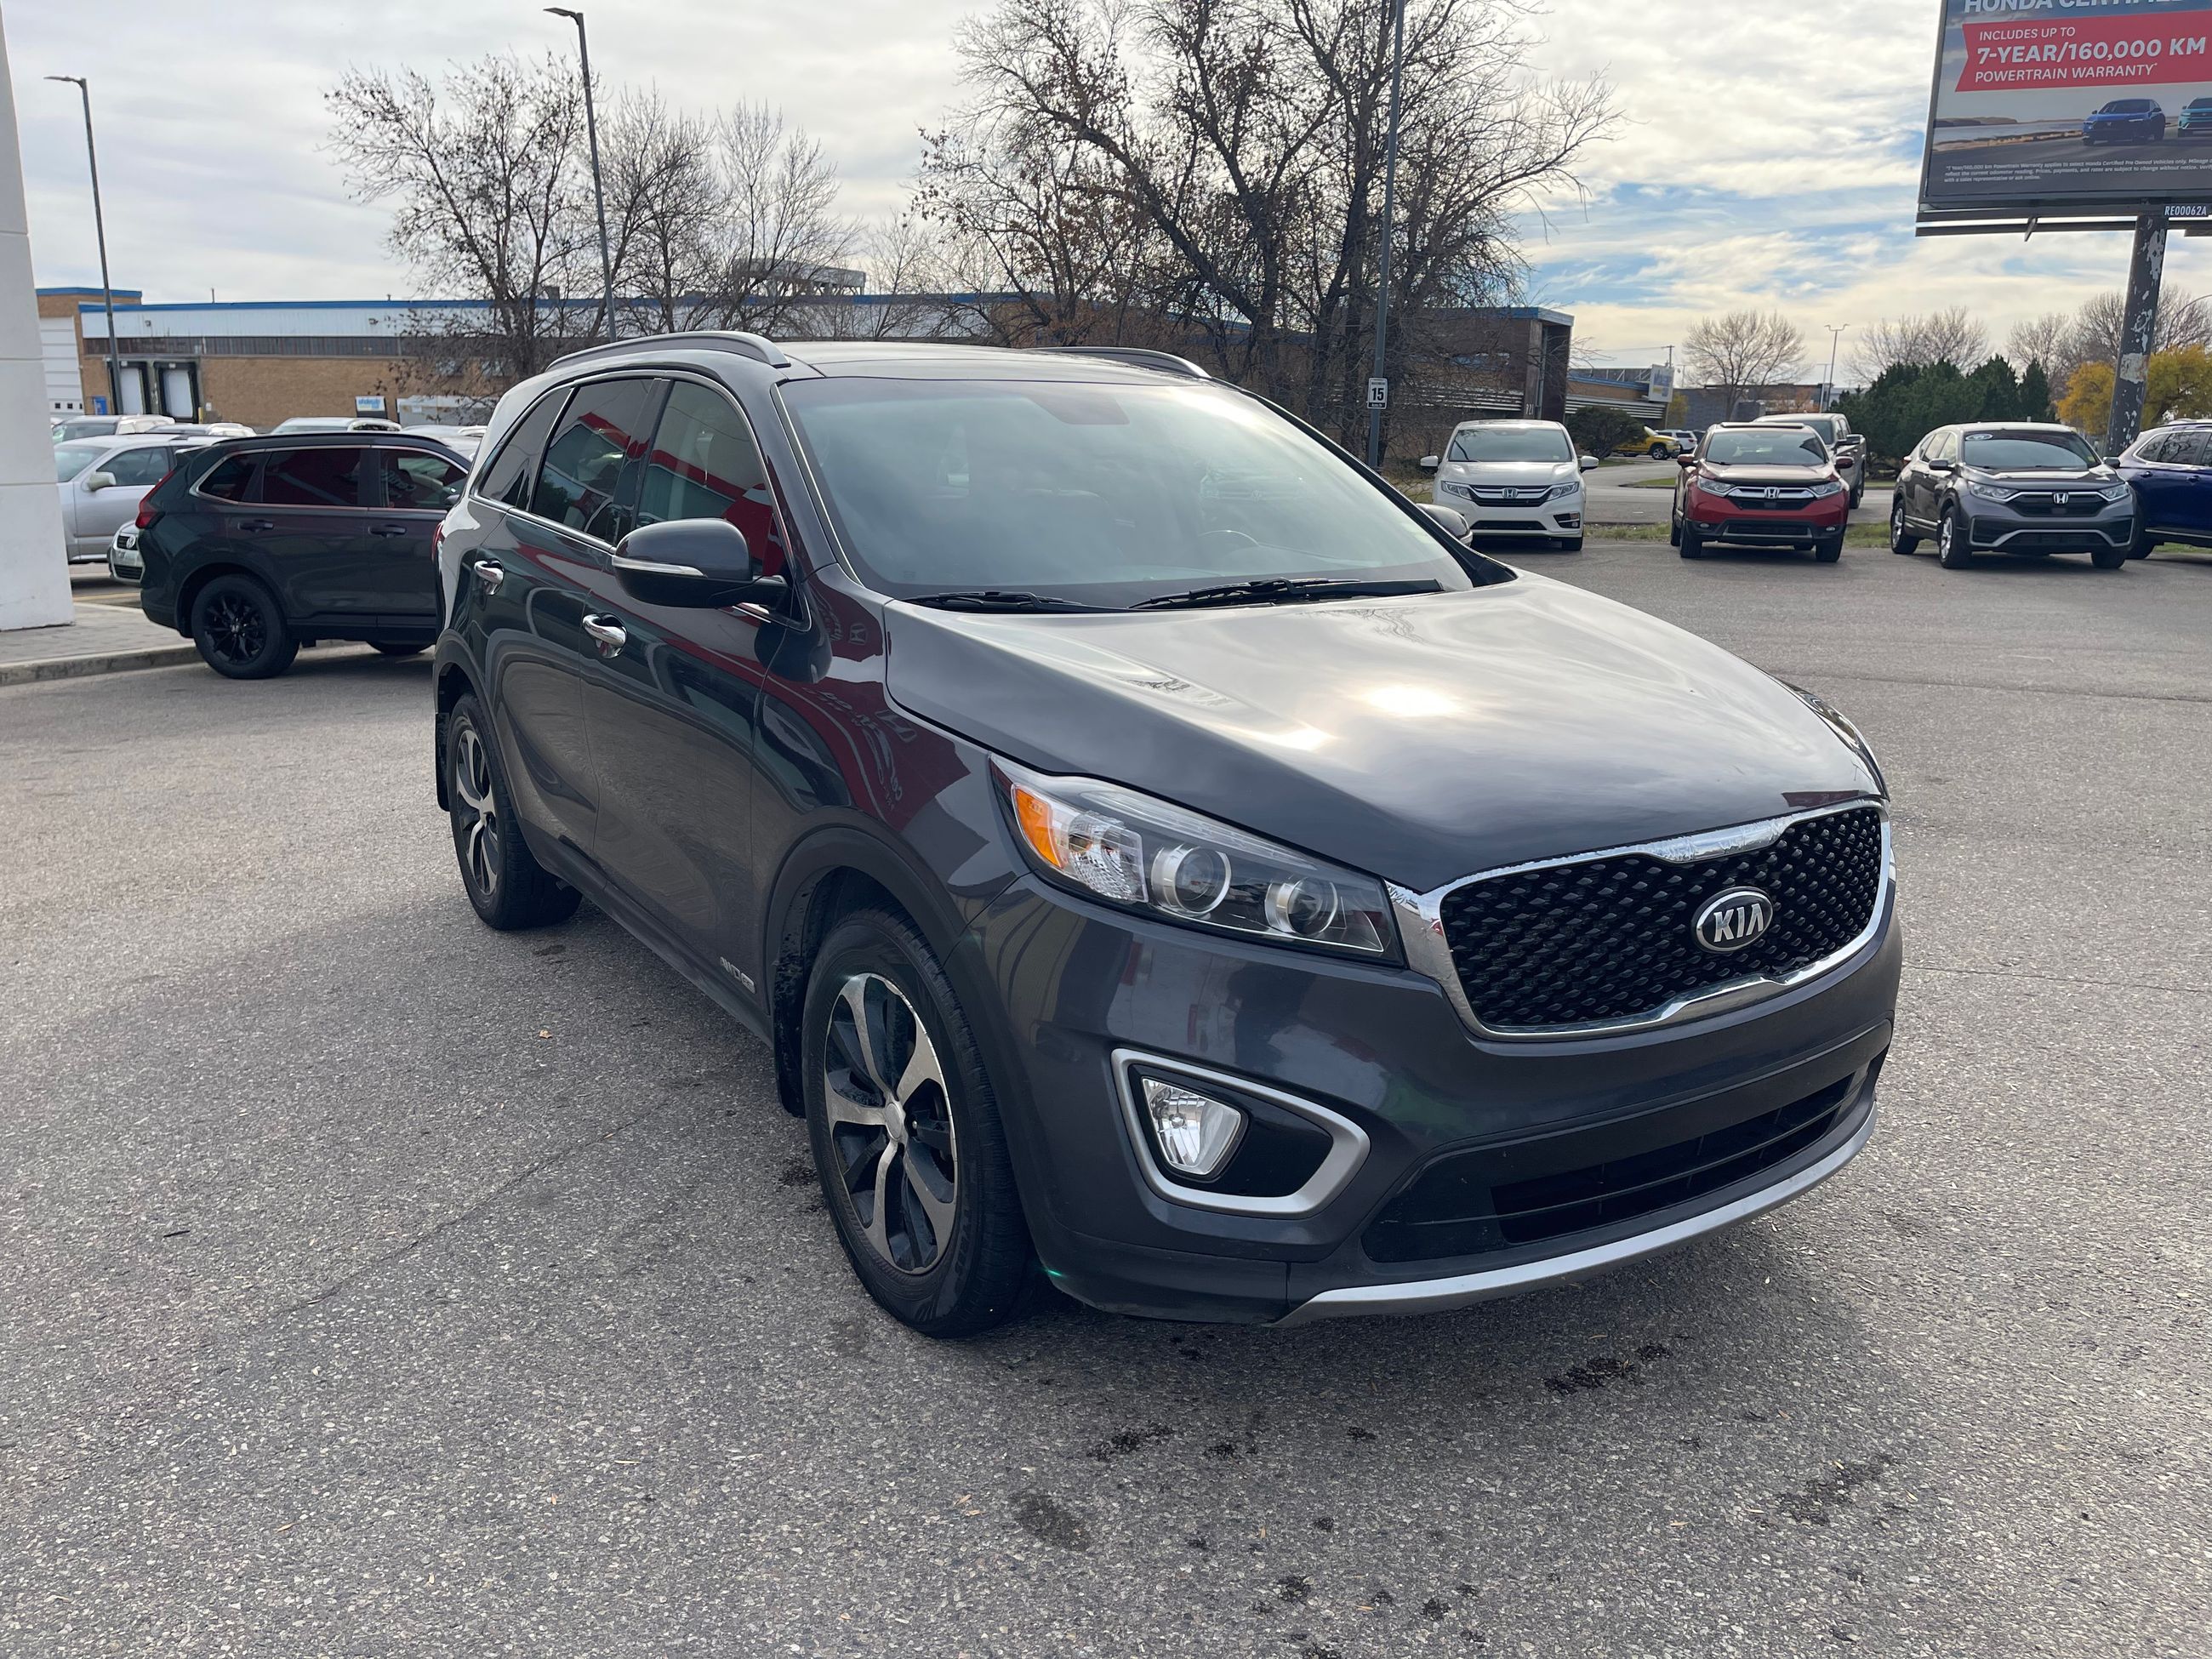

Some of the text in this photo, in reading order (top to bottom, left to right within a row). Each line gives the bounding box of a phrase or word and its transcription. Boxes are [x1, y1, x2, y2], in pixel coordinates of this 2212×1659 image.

[1980, 26, 2076, 41] INCLUDES UP TO
[1977, 37, 2206, 64] 7-YEAR/160,000 KM
[1975, 67, 2067, 83] POWERTRAIN
[2164, 205, 2207, 216] RE00062A
[1371, 387, 1384, 401] 15
[1713, 903, 1764, 943] KIA
